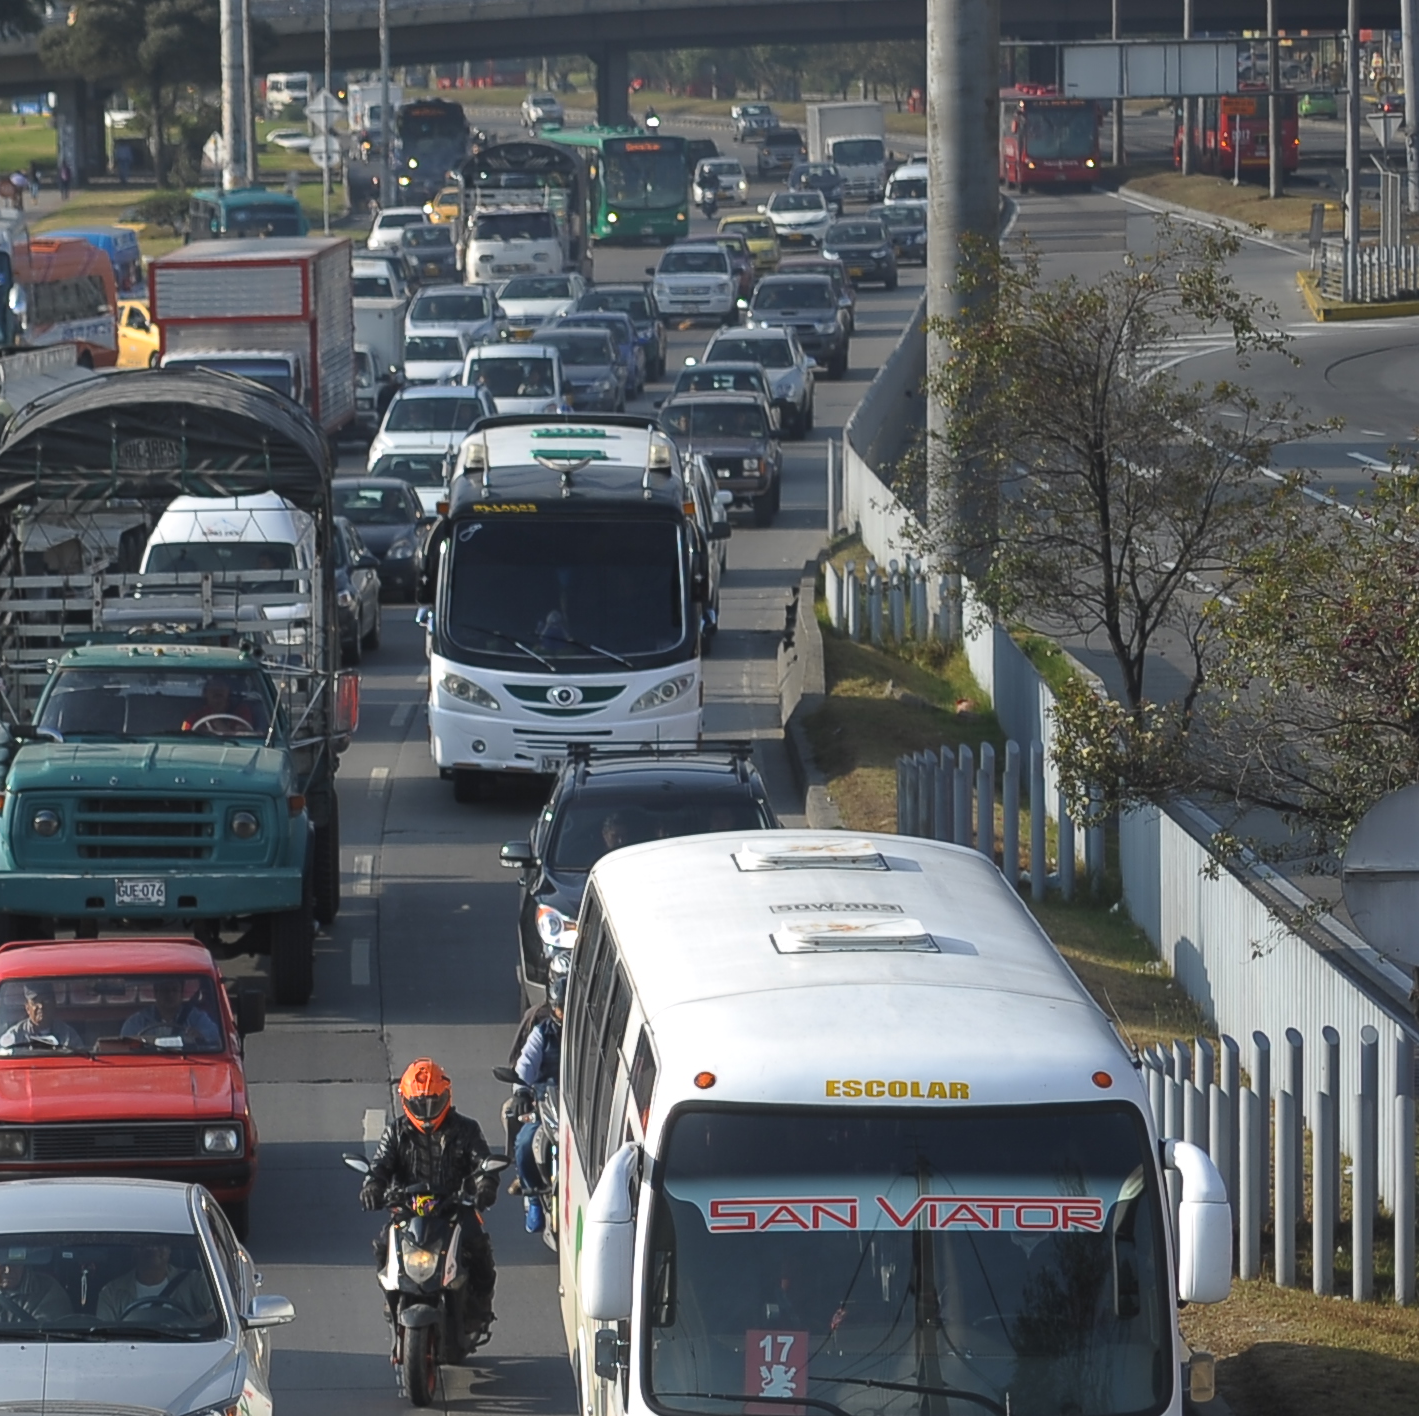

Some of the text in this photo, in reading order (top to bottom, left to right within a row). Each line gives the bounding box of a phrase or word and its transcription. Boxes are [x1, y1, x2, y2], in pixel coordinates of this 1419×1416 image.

[825, 1080, 970, 1100] ESCOLAR
[708, 1195, 1105, 1233] SAN VIATOR
[759, 1334, 795, 1363] 17
